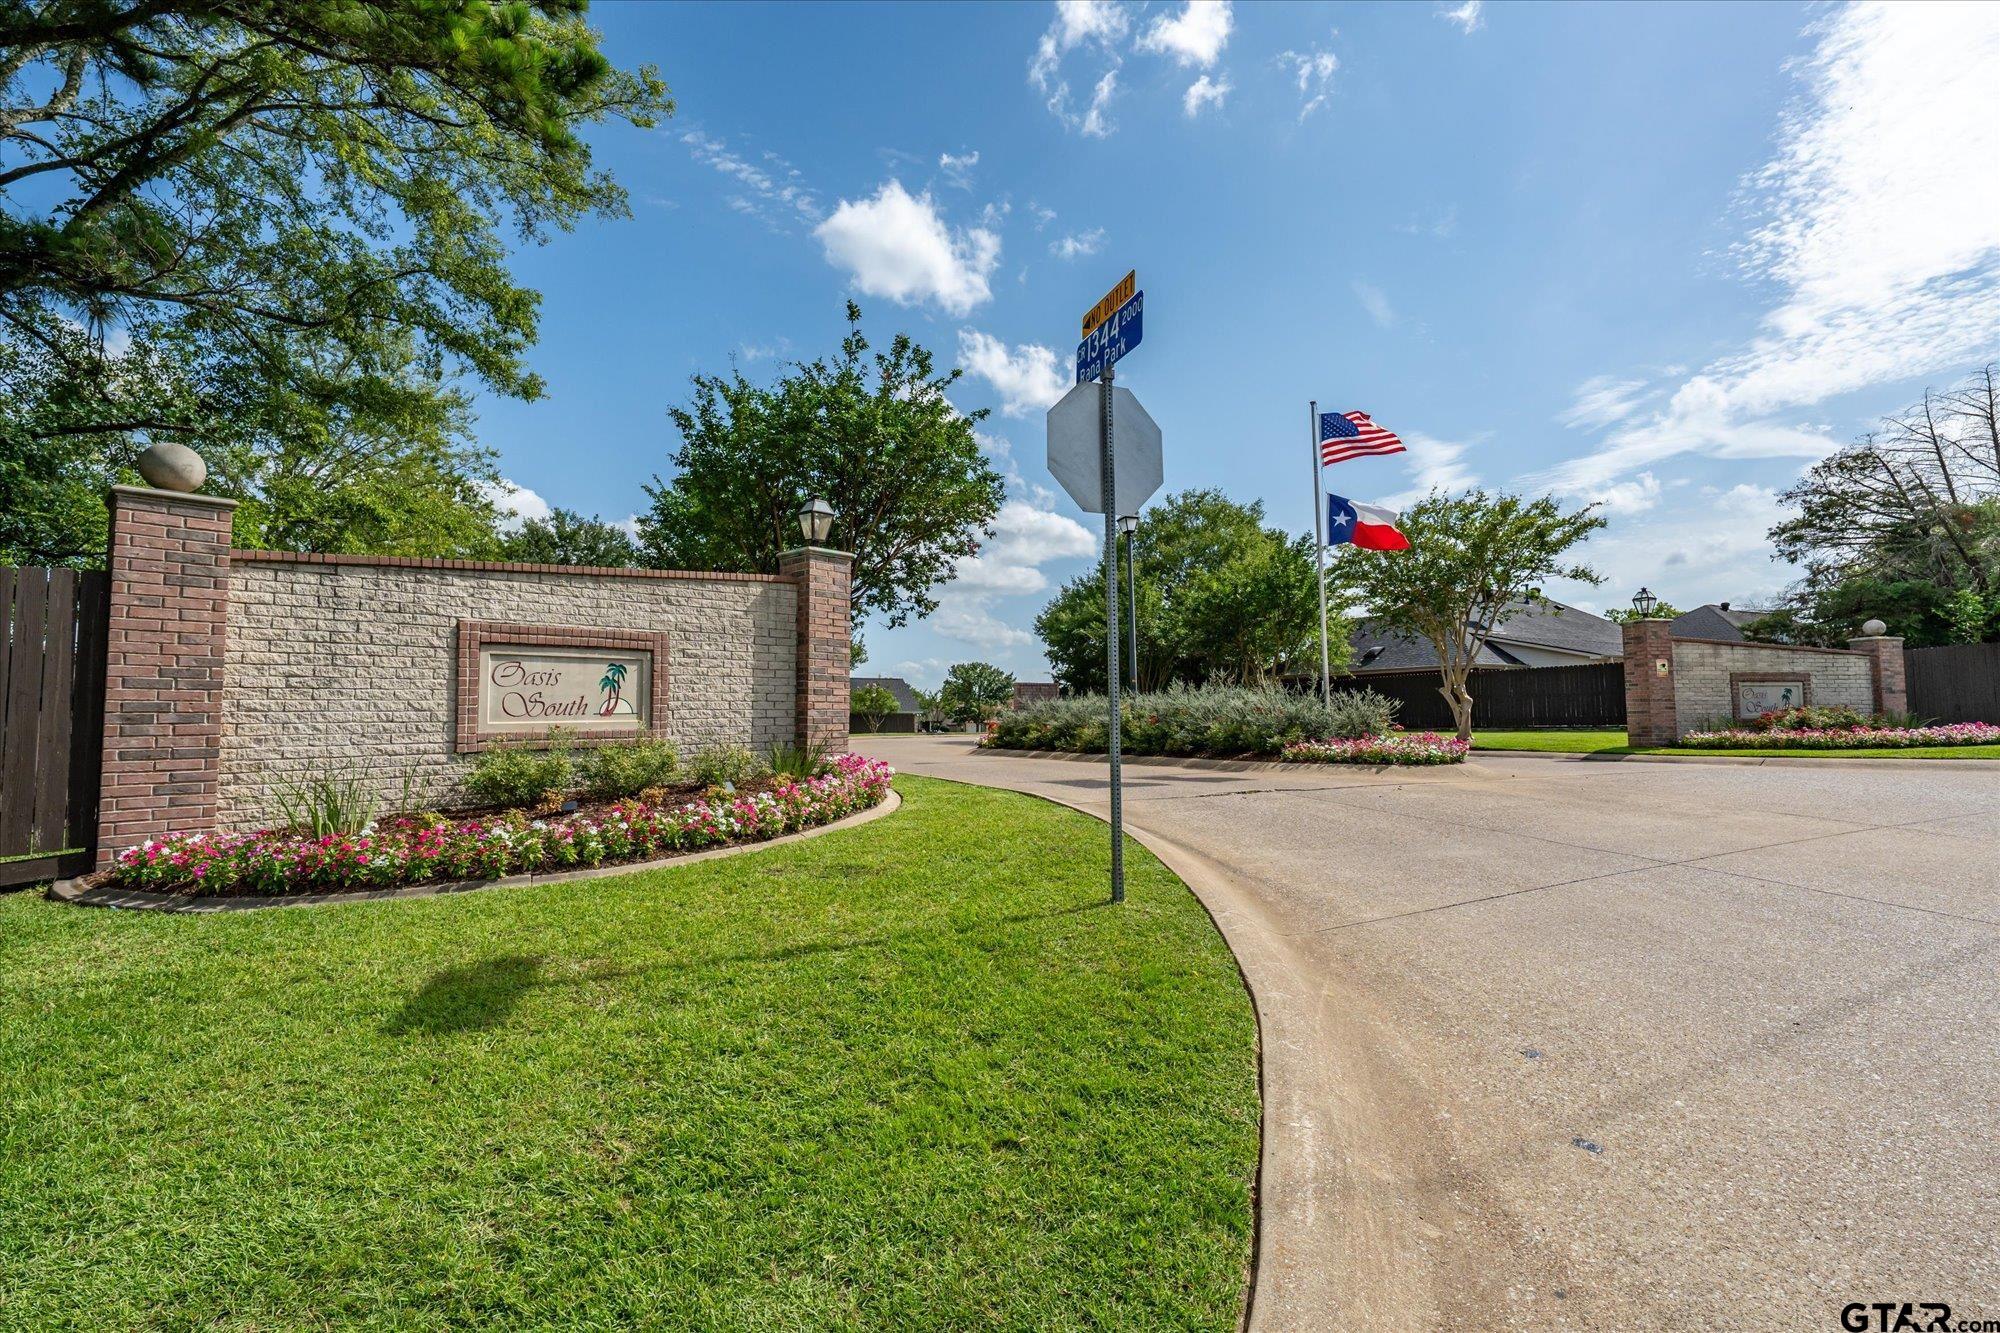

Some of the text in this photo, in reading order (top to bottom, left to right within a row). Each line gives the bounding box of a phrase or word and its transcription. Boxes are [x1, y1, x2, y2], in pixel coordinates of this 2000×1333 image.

[1089, 274, 1134, 329] NO OUTLET
[1077, 296, 1143, 363] CR 1344 2000
[1080, 337, 1127, 383] Rana Park
[491, 661, 562, 687] Oasis
[501, 691, 588, 717] South
[1742, 687, 1768, 700] Oasis
[1746, 701, 1778, 713] South
